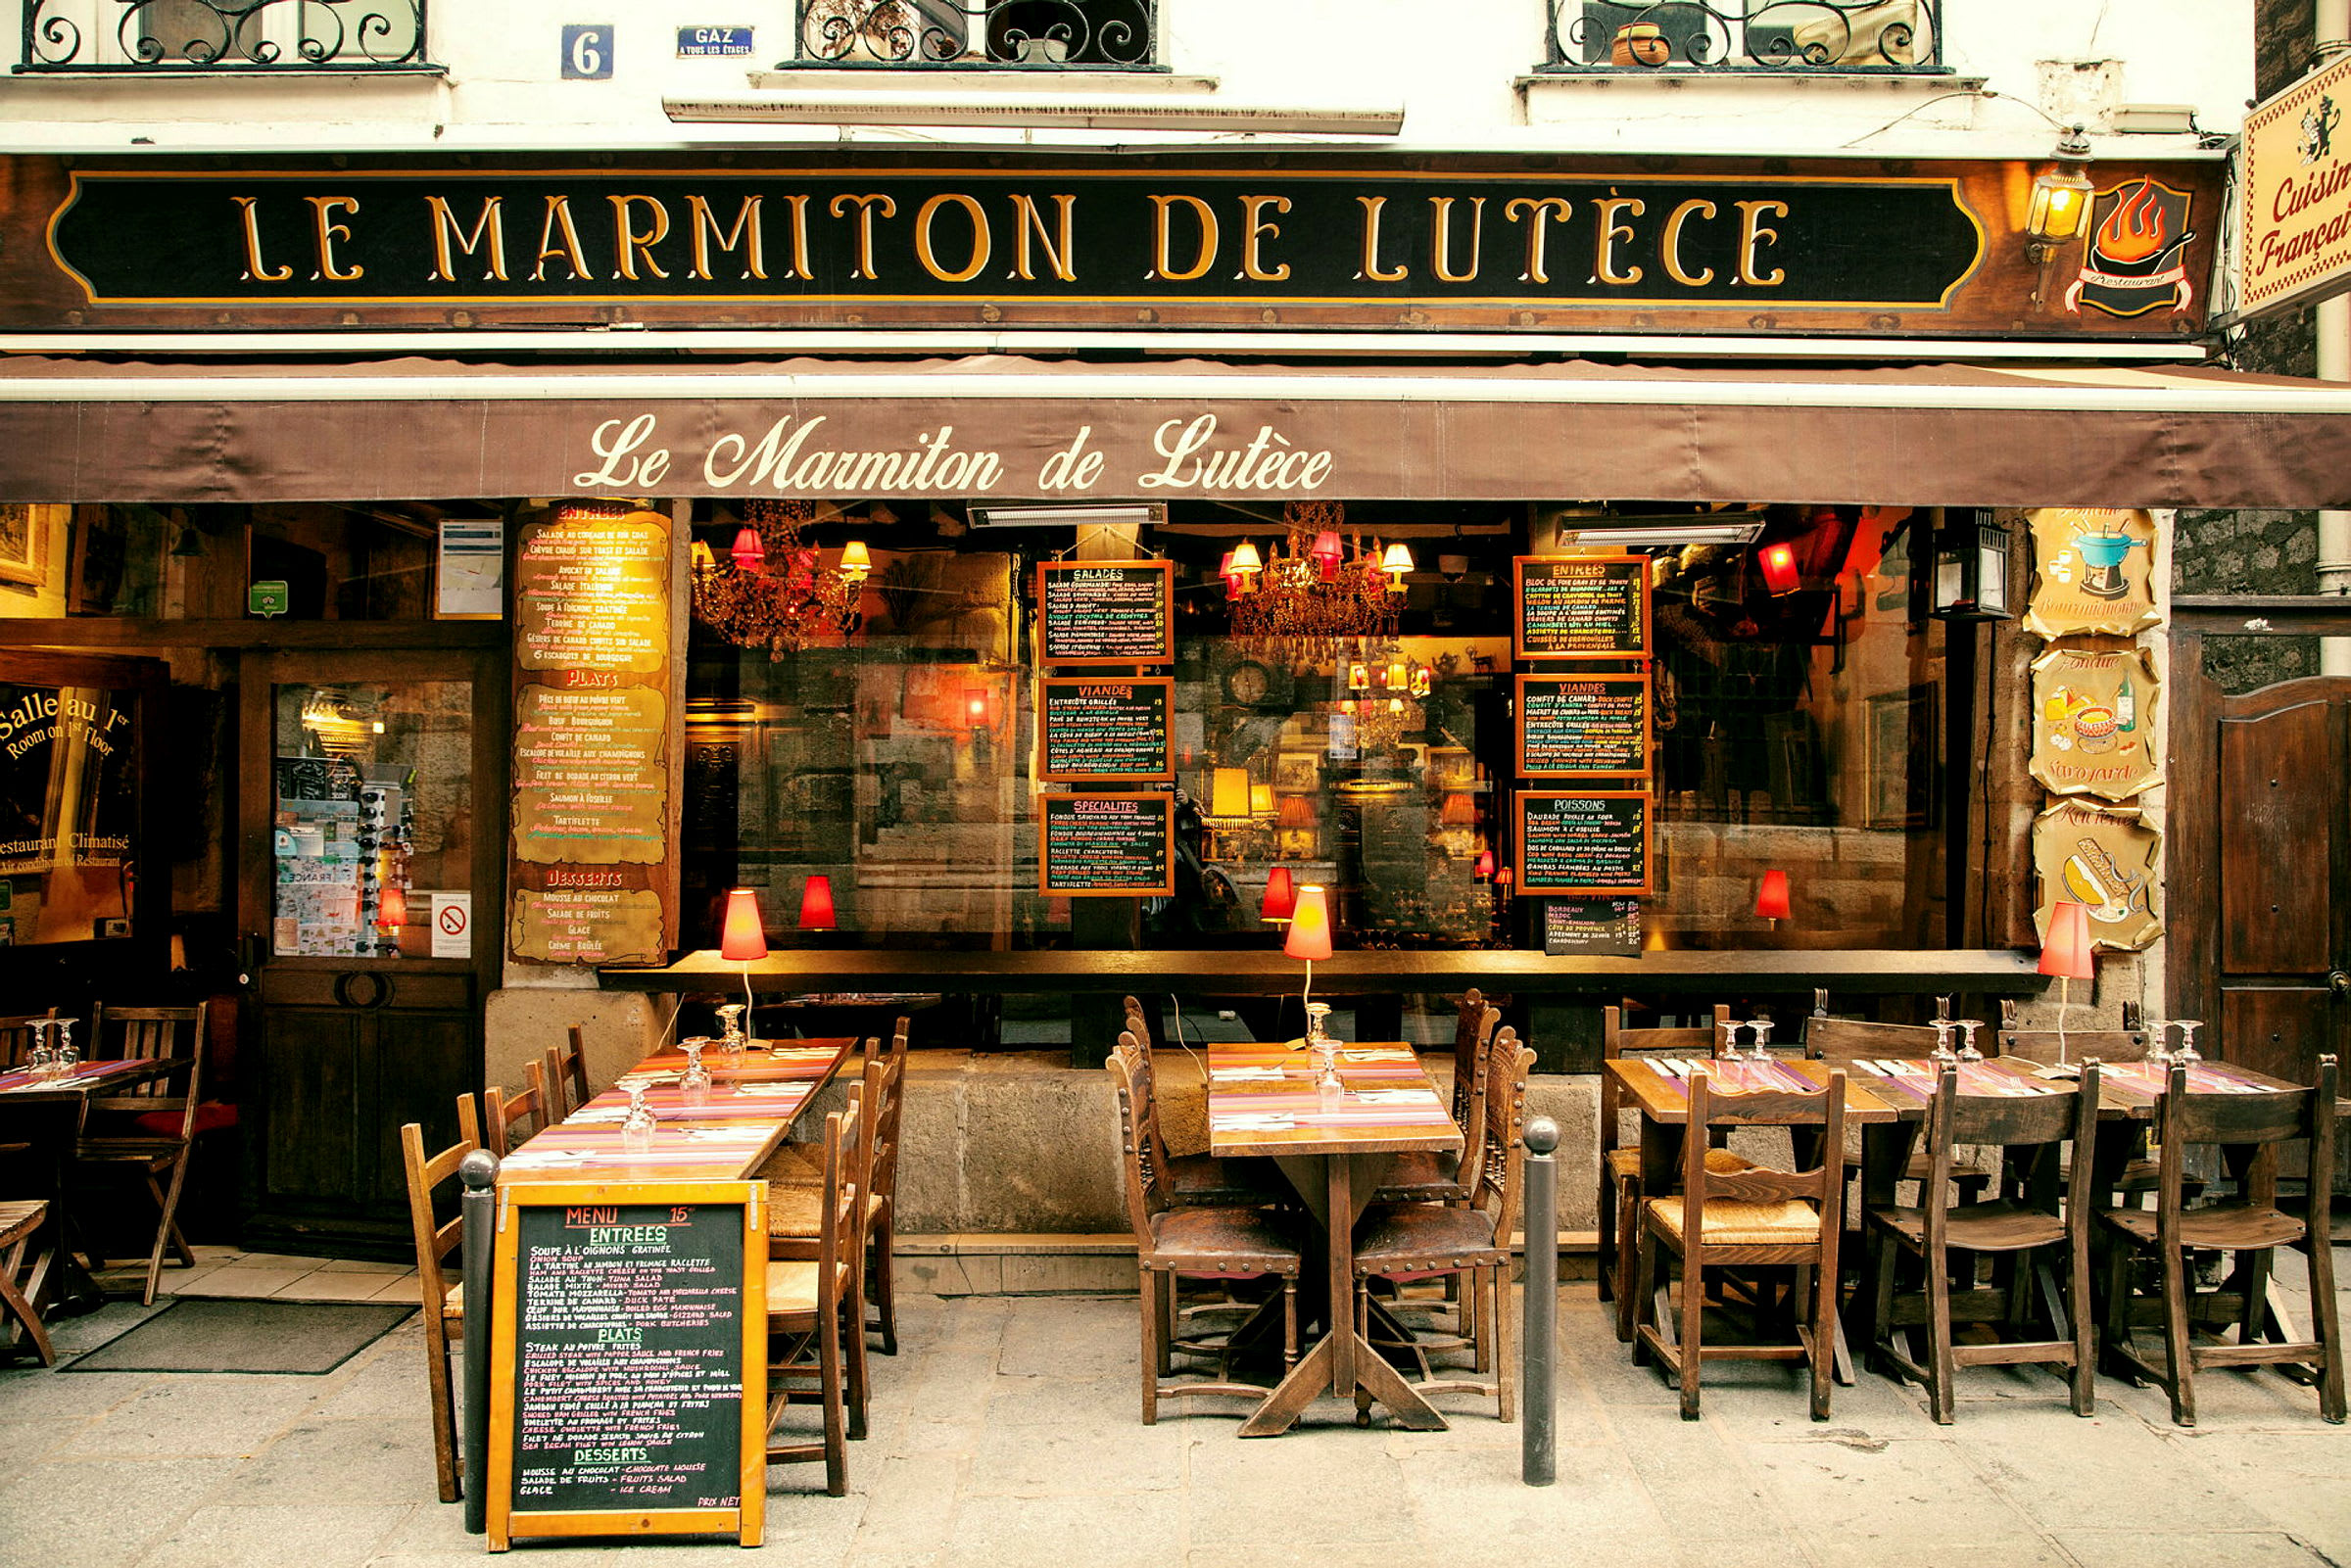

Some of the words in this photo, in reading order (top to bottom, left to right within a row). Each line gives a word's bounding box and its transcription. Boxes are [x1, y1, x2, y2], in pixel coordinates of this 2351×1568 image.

[696, 28, 734, 44] GAZ
[572, 31, 600, 74] 6
[686, 46, 705, 55] TOUS
[723, 44, 749, 54] ÉTAGES
[2273, 159, 2351, 223] Cuisin
[231, 195, 364, 283] LE
[424, 194, 1079, 284] MARMITON
[1144, 194, 1292, 282] DE
[1353, 186, 1790, 285] LUTÈCE
[2255, 201, 2351, 277] Françai
[2090, 273, 2165, 286] Restaurant
[572, 412, 670, 489] Le
[702, 414, 1005, 492] Marmiton
[1038, 424, 1105, 492] de
[1137, 412, 1337, 492] Lutèce
[1073, 569, 1125, 580] SALADES
[566, 669, 618, 687] PLATS
[1078, 686, 1133, 697] VIANDES
[1559, 683, 1607, 693] VIANDES
[0, 692, 59, 741] Salle
[67, 698, 97, 722] au
[6, 729, 47, 760] Room
[47, 725, 64, 738] on
[83, 726, 115, 757] floor
[1554, 799, 1607, 811] POISSONS
[0, 837, 61, 855] estaurant
[69, 832, 130, 850] Climatisé
[547, 869, 623, 886] DESSERTS
[564, 1207, 619, 1224] MENU
[590, 1225, 667, 1243] ENTREES
[530, 1245, 562, 1257] SOUPE
[598, 1327, 644, 1341] PLATS
[525, 1342, 559, 1353] STEAK
[574, 1448, 648, 1463] DESSERTS
